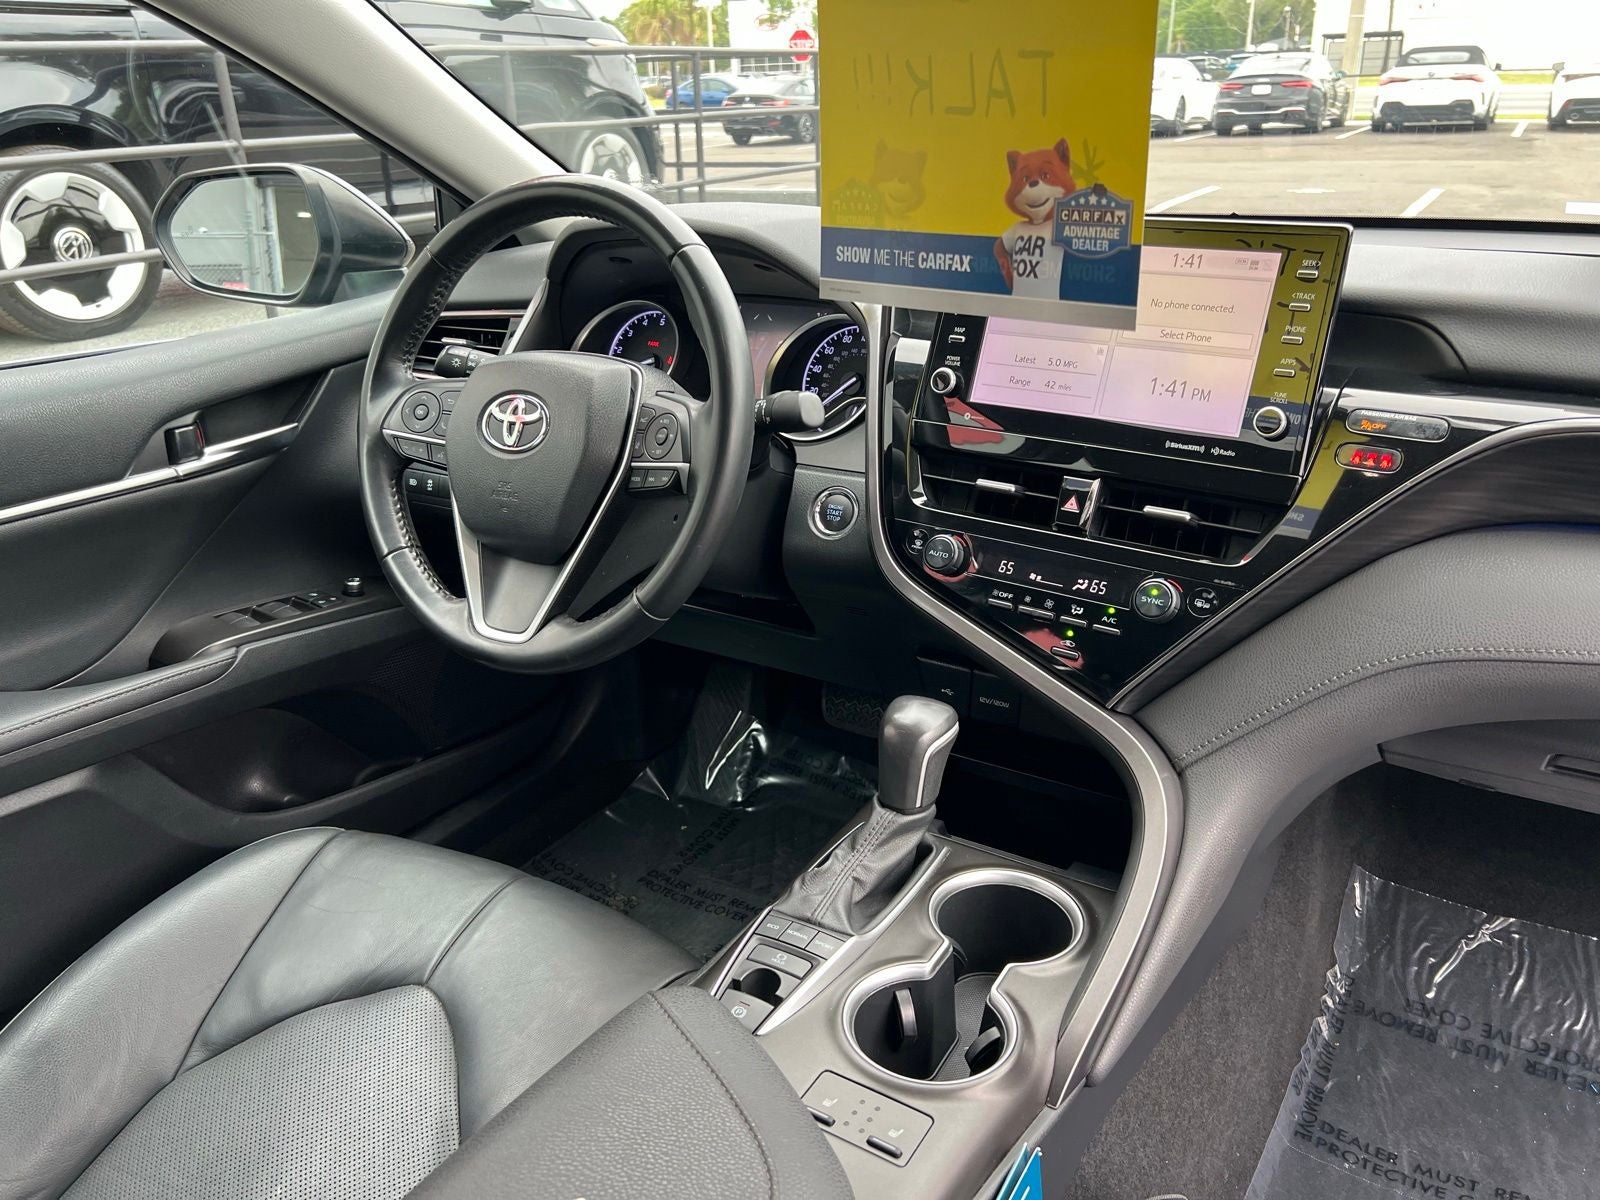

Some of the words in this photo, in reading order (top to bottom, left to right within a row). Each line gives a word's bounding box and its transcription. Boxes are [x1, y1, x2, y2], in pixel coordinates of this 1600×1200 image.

[790, 39, 814, 48] STOP
[1061, 210, 1125, 224] CARFAX
[1063, 226, 1120, 239] ADVANTAGE
[1015, 235, 1045, 257] CAR
[1072, 239, 1109, 251] DEALER
[836, 245, 870, 264] SHOW
[873, 247, 891, 266] ME
[893, 249, 915, 268] THE
[917, 251, 972, 272] CARFAX
[1172, 253, 1203, 269] 1:41
[1295, 292, 1316, 300] TRACK
[1150, 299, 1163, 309] No
[1164, 300, 1188, 313] phone
[1191, 303, 1236, 314] connected.
[659, 318, 667, 326] 5
[627, 329, 634, 337] 3
[1160, 329, 1184, 340] Select
[1185, 332, 1212, 342] Phone
[1285, 325, 1307, 333] PHONE
[842, 335, 853, 343] 80
[824, 346, 834, 355] 60
[1014, 354, 1036, 364] Latest
[1047, 357, 1062, 367] 5.0
[1063, 360, 1078, 369] MPG
[812, 365, 823, 373] 40
[1009, 375, 1031, 388] Range
[1044, 380, 1056, 390] 42
[1057, 383, 1072, 392] miles
[1150, 376, 1187, 398] 1:41
[1191, 387, 1212, 403] PM
[1219, 449, 1236, 457] Radio
[928, 549, 949, 559] AUTO
[998, 560, 1014, 575] 65
[1090, 580, 1108, 595] 65
[999, 591, 1014, 600] OFF
[1140, 595, 1164, 606] SYNC
[1101, 615, 1117, 624] A/C
[979, 696, 1010, 708] 12V/120W
[694, 887, 727, 902] MUST
[704, 903, 749, 922] COVER
[1350, 999, 1438, 1044] REMOVE
[1451, 1036, 1510, 1067] MUST
[1524, 1058, 1588, 1091] EALER
[1317, 1118, 1399, 1165] DEALER
[1412, 1161, 1480, 1193] MUST
[1312, 1135, 1450, 1200] PROTECTIVE
